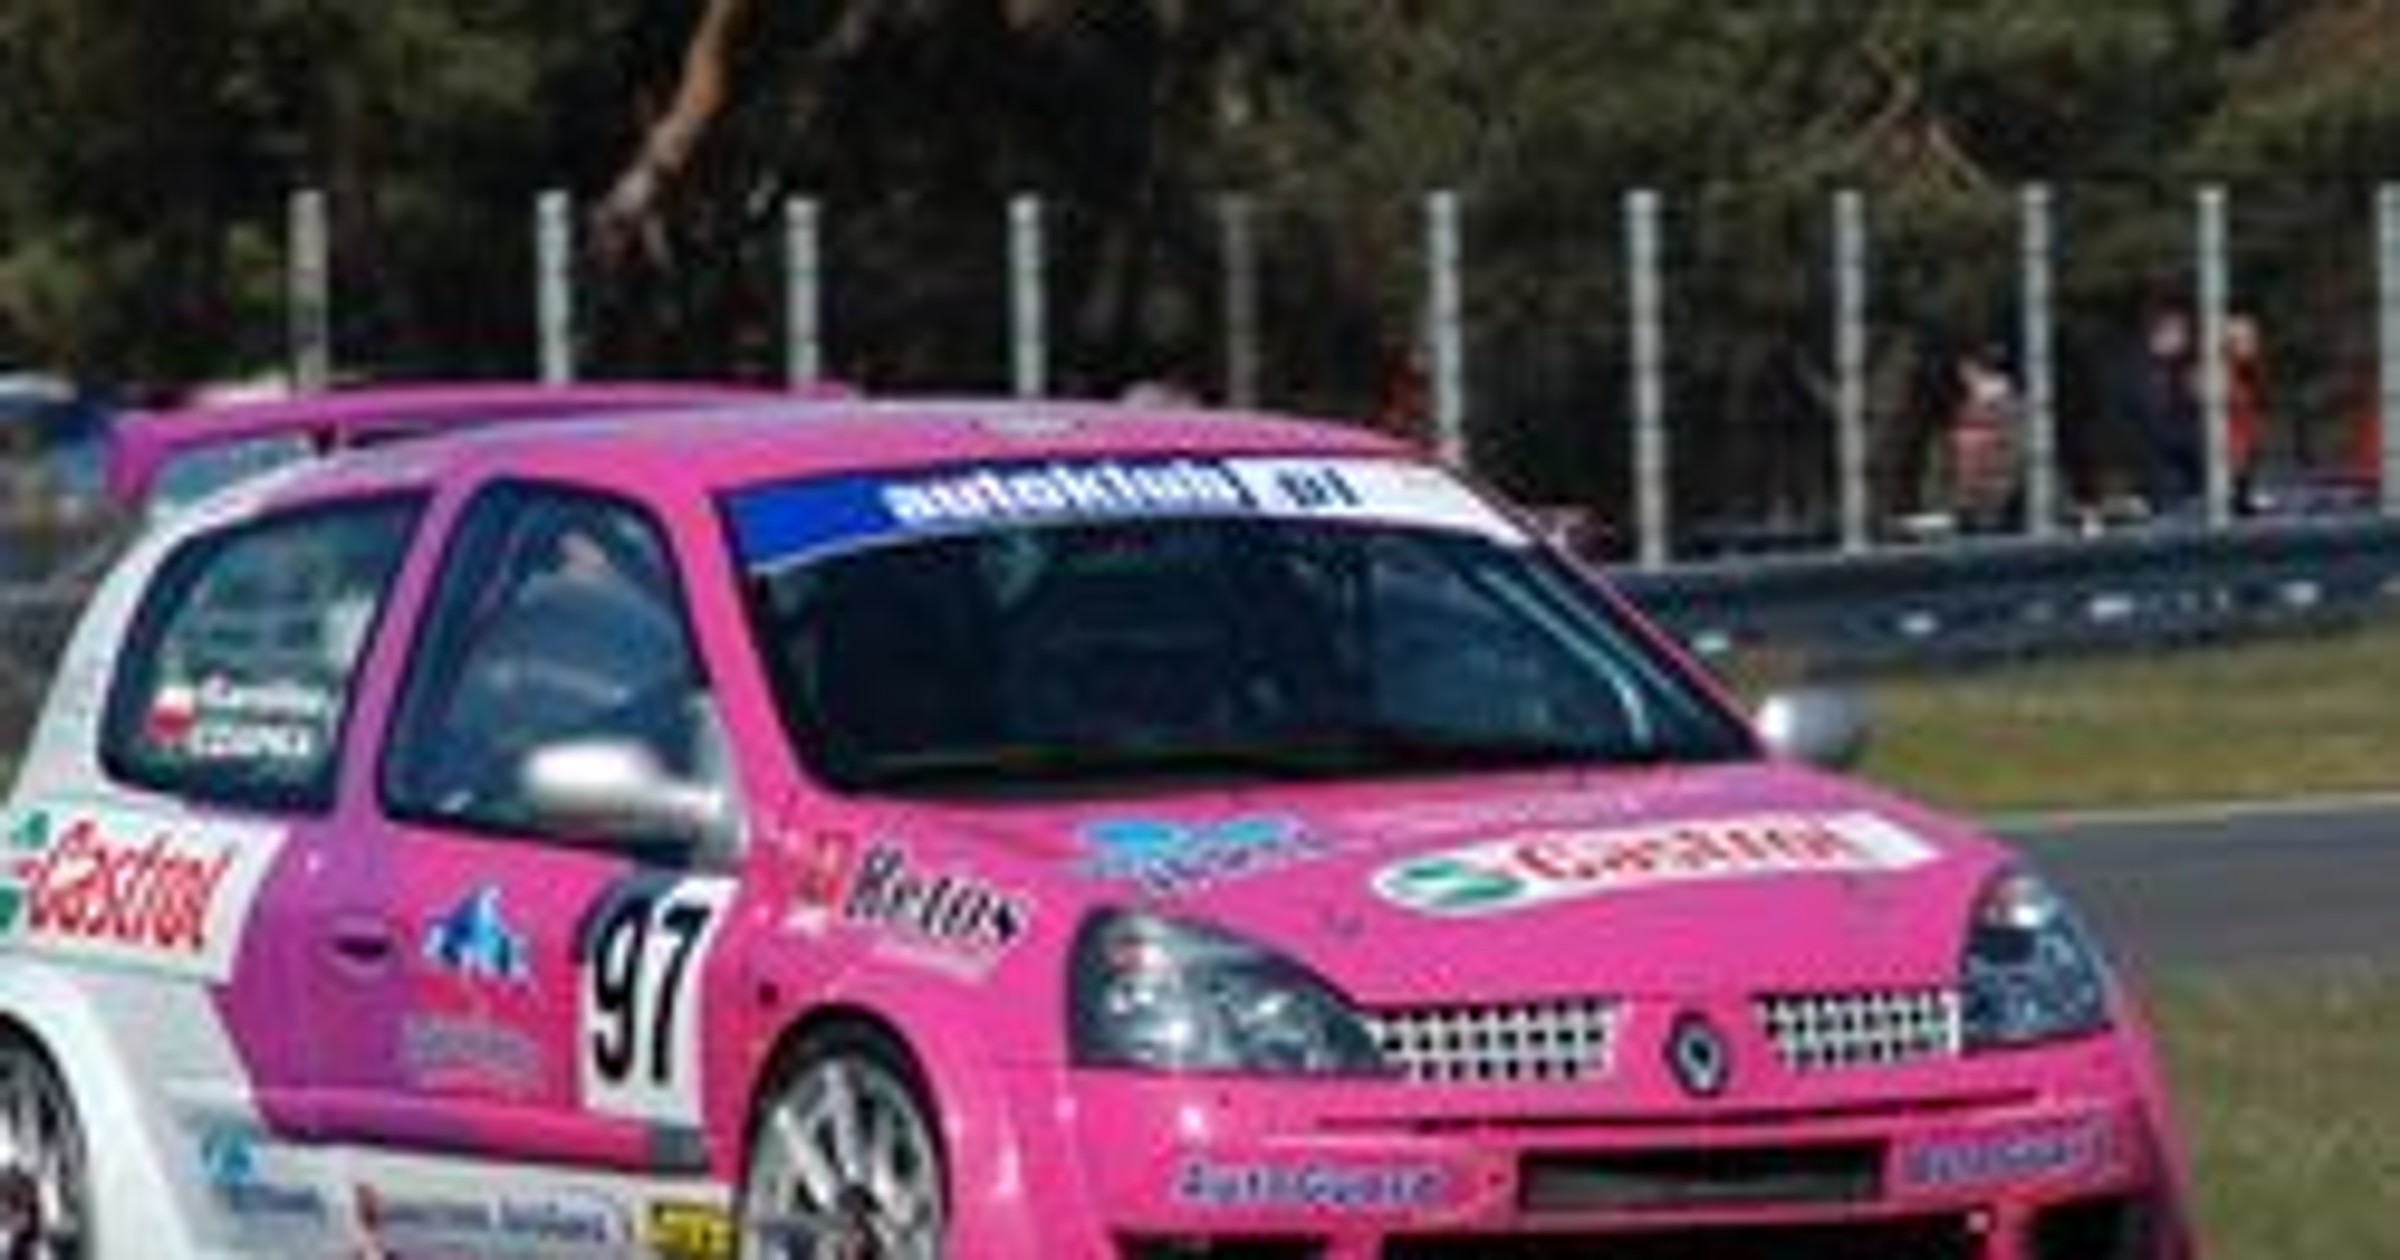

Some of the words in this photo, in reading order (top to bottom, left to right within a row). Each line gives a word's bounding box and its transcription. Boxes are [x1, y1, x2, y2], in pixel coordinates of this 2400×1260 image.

[18, 818, 240, 952] Castrol
[1512, 812, 1862, 882] Castrol
[592, 890, 712, 1086] 97
